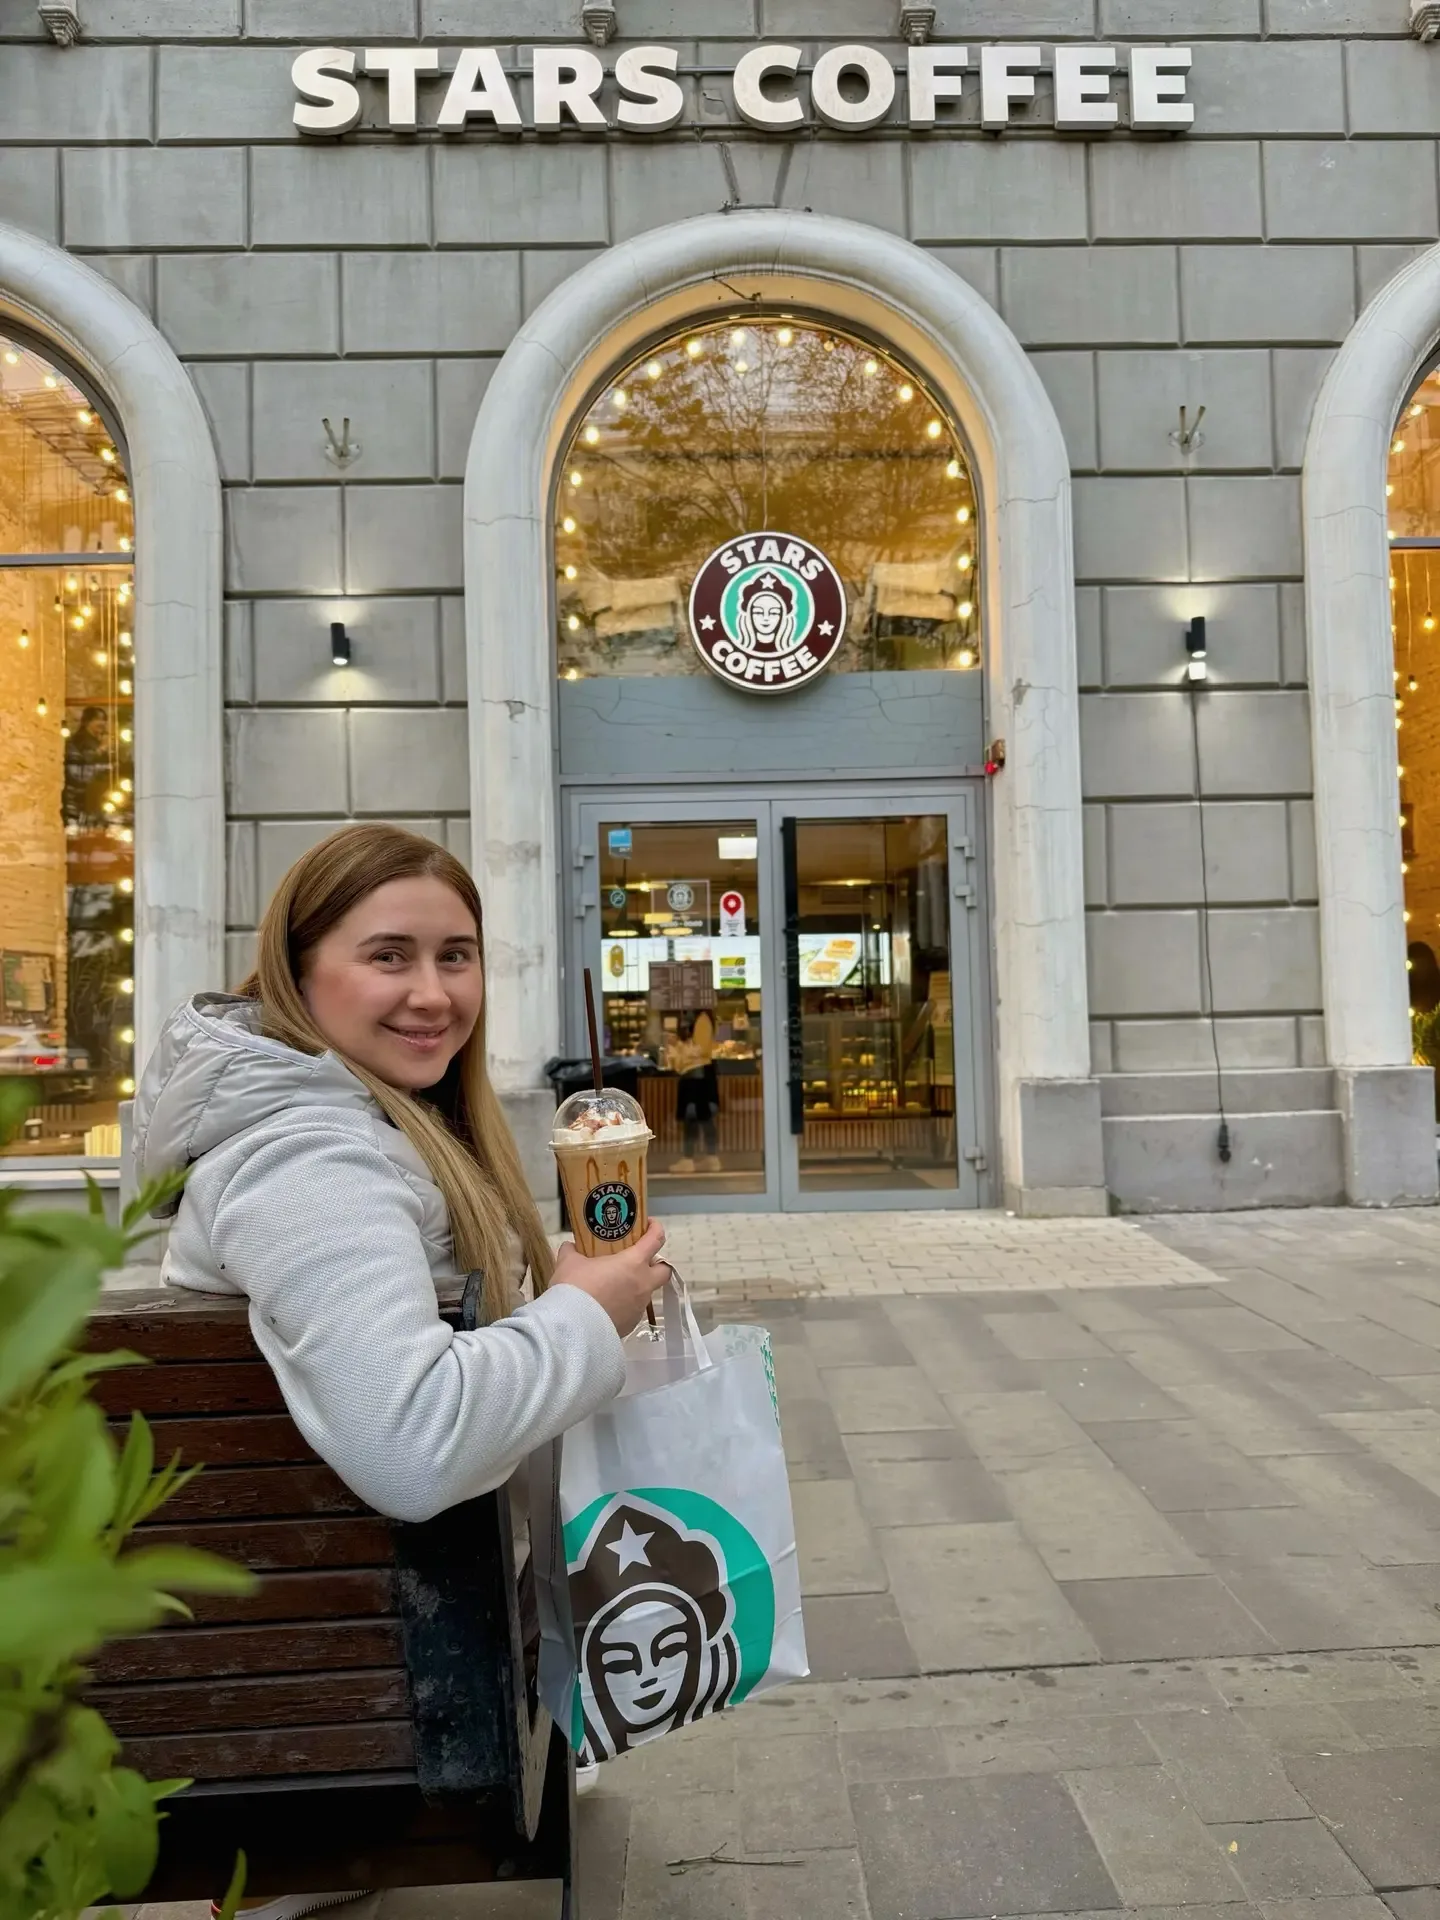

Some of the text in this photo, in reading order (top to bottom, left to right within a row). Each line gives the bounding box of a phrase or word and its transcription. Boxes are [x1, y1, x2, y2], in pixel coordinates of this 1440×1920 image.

[291, 44, 1195, 133] STARS COFFEE
[719, 538, 824, 581] STARS
[711, 639, 819, 682] COFFEE
[593, 1185, 630, 1200] STARS
[594, 1223, 630, 1238] COFFEE
